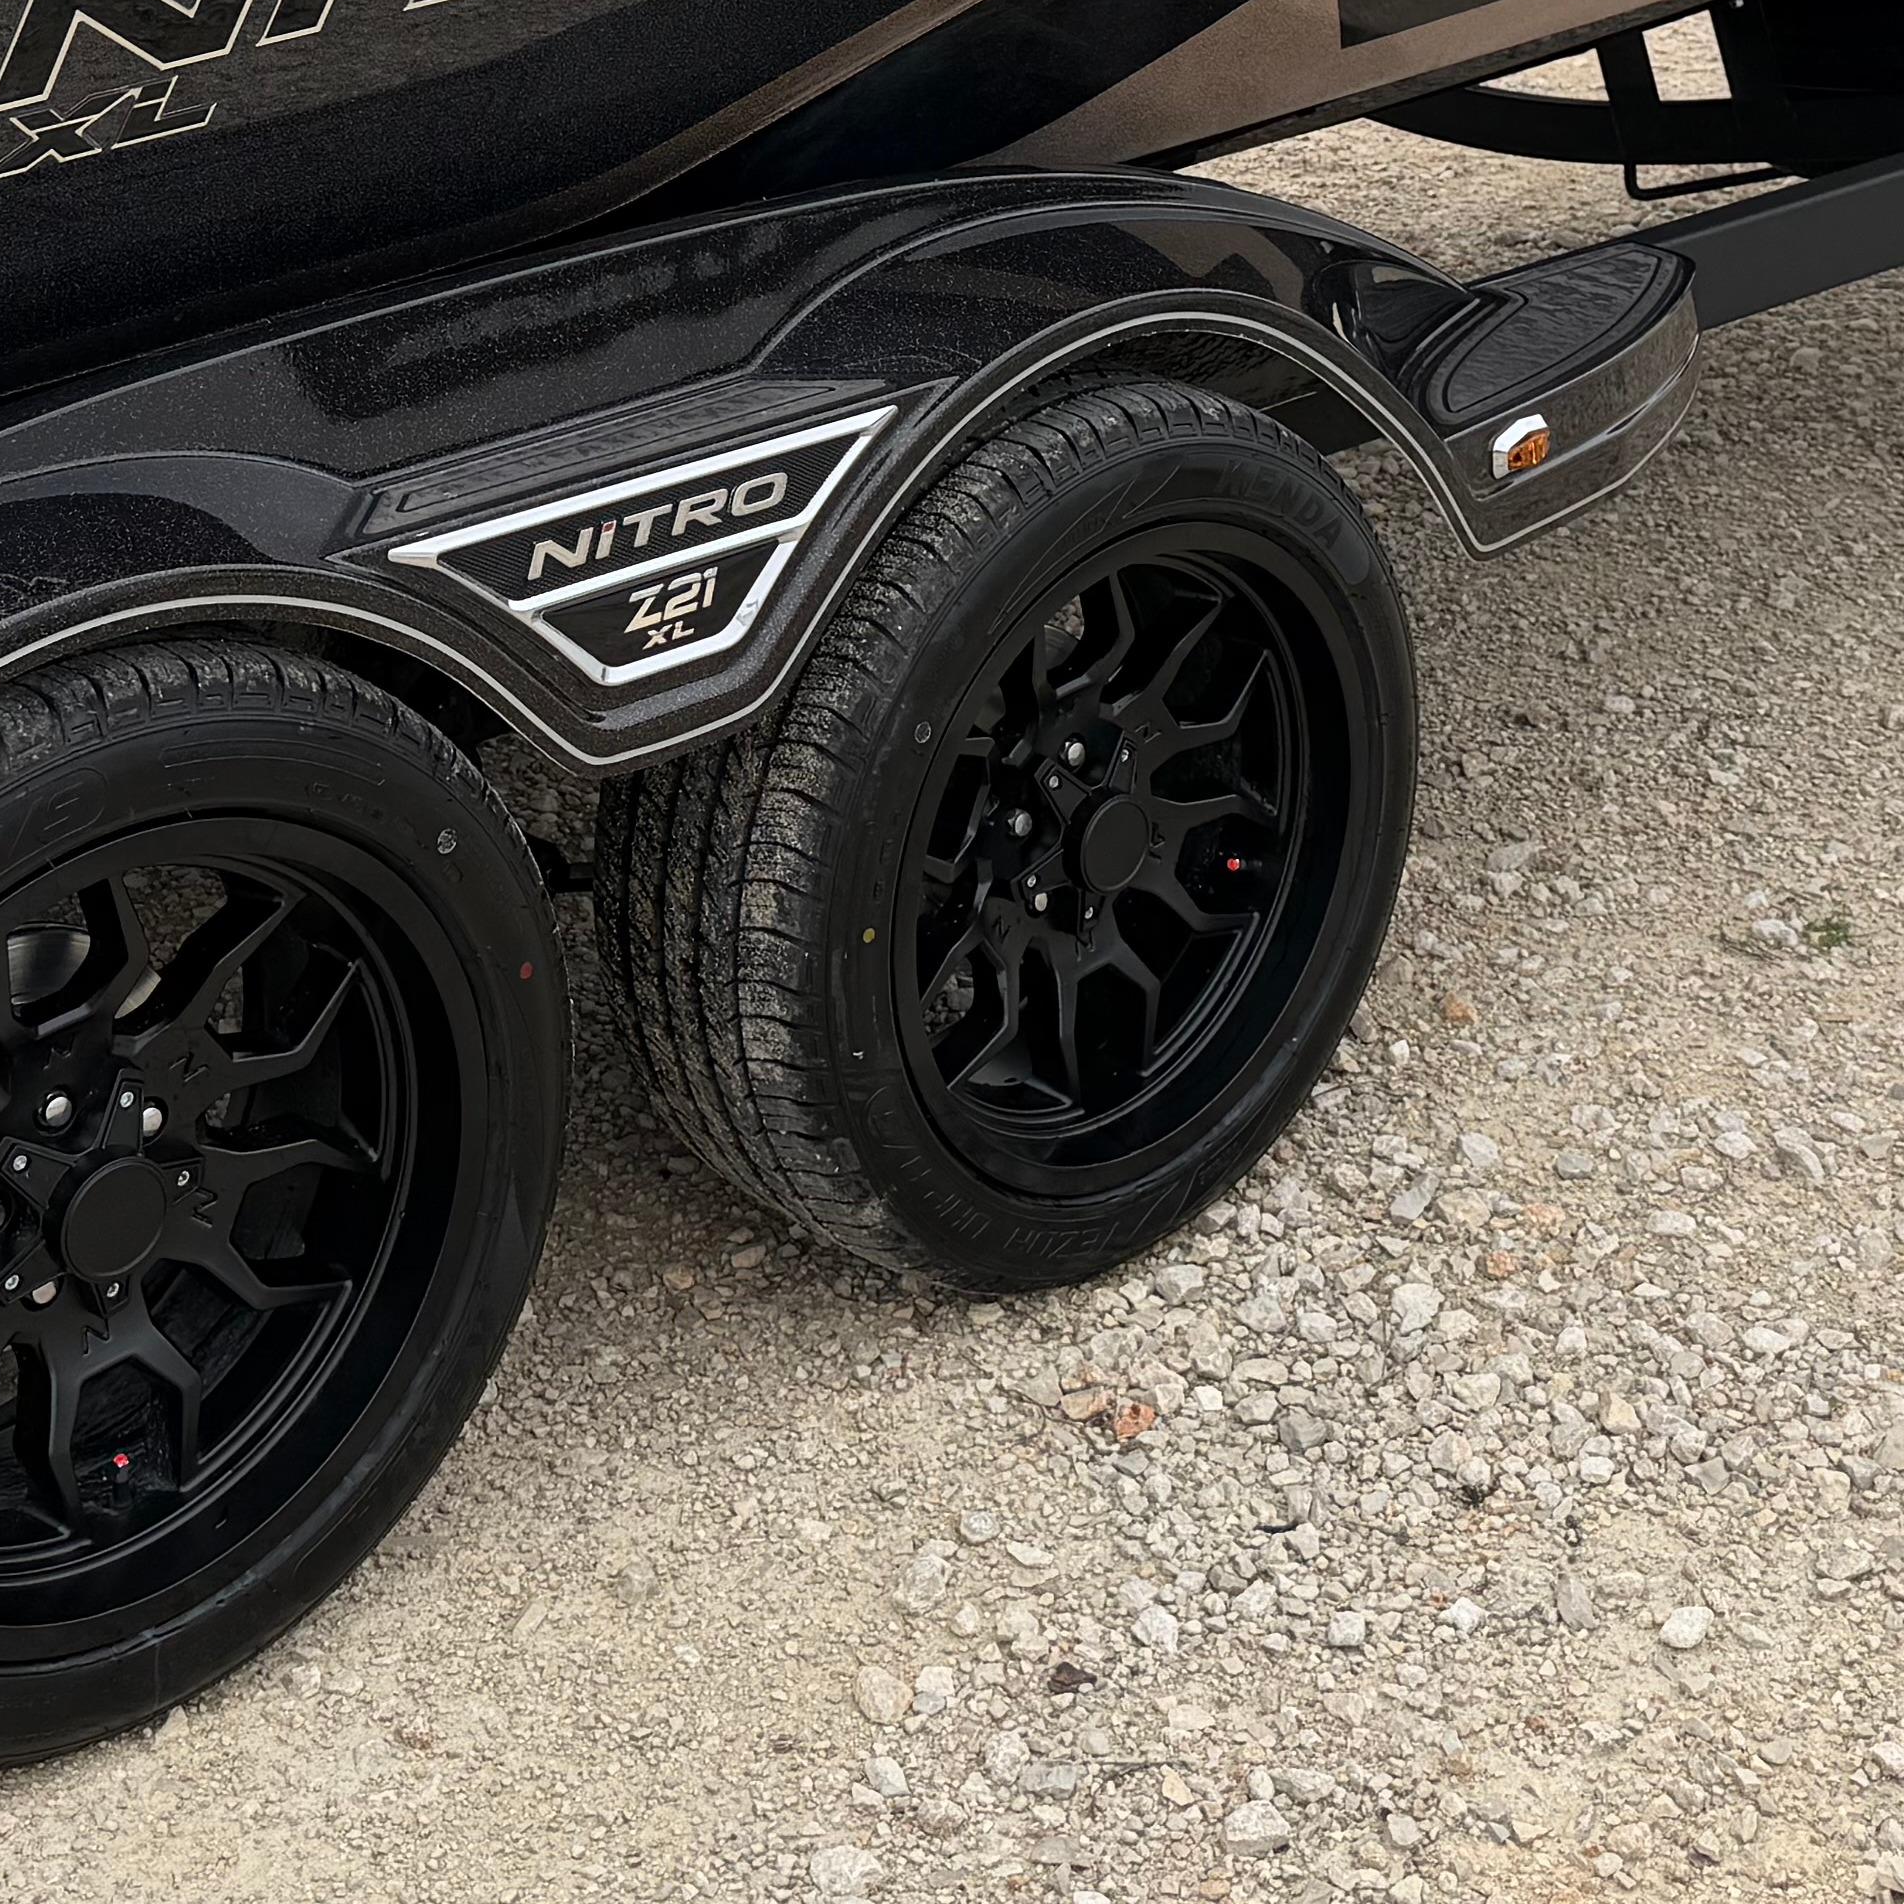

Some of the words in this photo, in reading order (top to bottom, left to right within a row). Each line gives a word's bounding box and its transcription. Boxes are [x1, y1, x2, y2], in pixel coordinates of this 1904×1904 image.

[527, 472, 788, 581] NITRO
[1217, 458, 1343, 550] KENDA
[624, 565, 720, 634] Z21
[643, 619, 695, 651] XL
